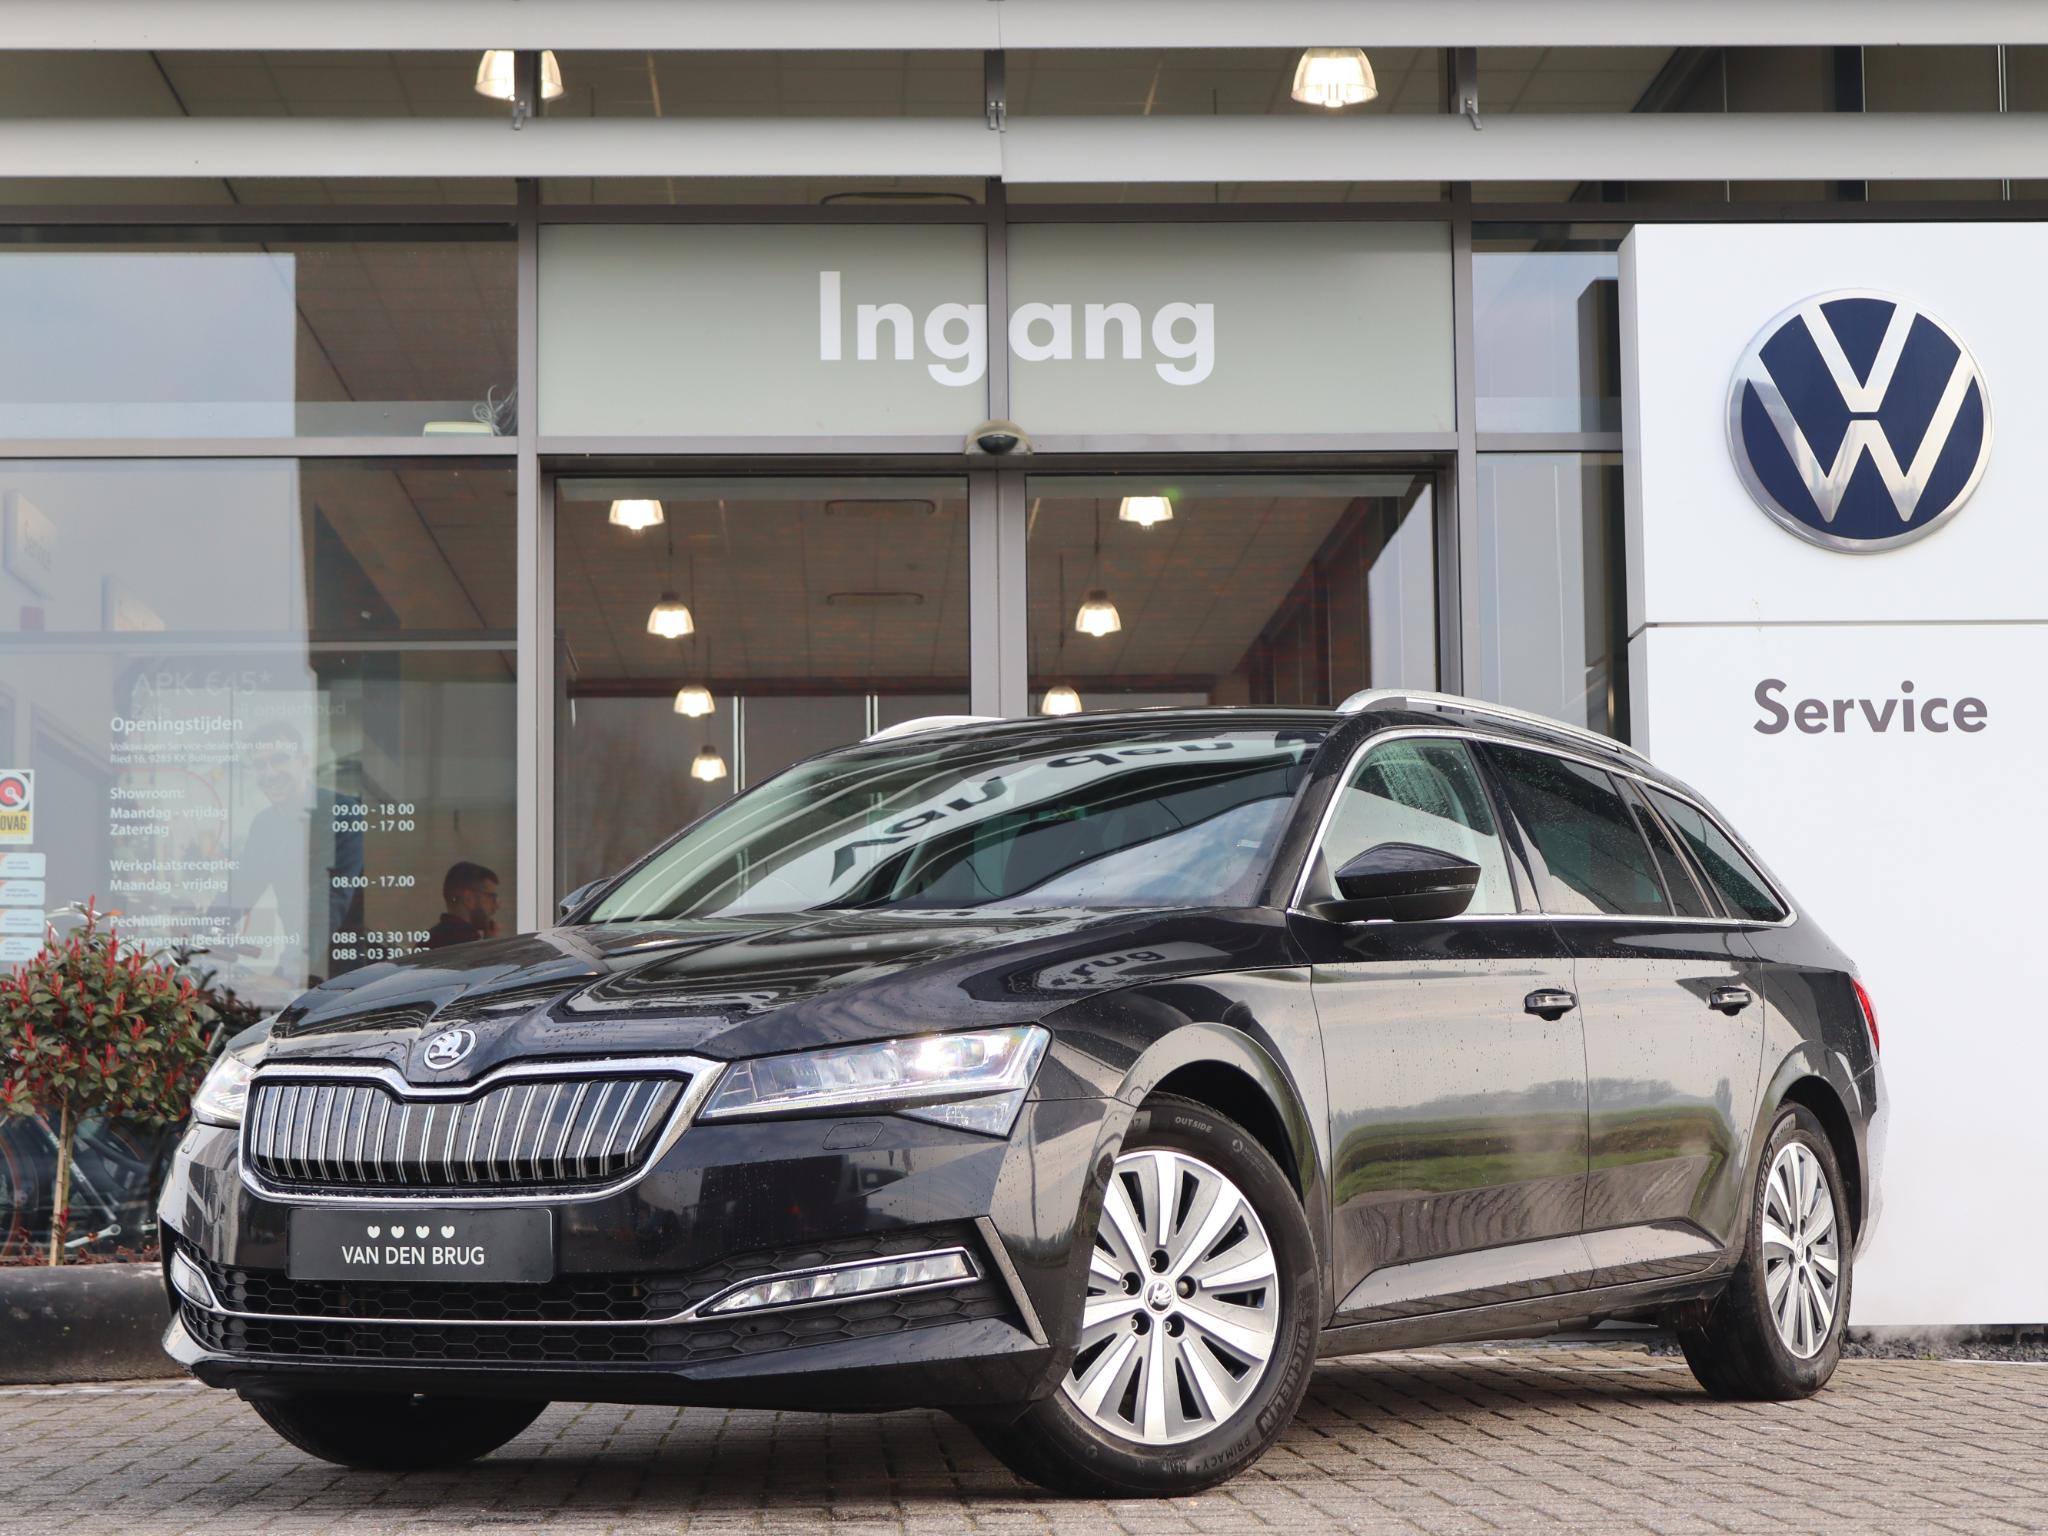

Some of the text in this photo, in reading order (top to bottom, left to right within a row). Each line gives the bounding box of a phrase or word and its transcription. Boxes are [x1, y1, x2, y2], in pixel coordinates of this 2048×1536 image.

[819, 270, 1216, 388] Ingang
[1735, 293, 1988, 540] VW
[1752, 678, 1988, 735] Service
[109, 716, 243, 736] Openingstijden
[109, 787, 185, 800] Showroom:
[109, 807, 172, 820] Maandag
[182, 805, 228, 820] vrijdag
[331, 804, 368, 817] 09.00
[109, 823, 170, 838] Zaterdag
[331, 820, 368, 833] 09.00
[109, 859, 241, 874] Werkplaatsreceptie:
[109, 879, 172, 893] Maandag
[182, 879, 228, 893] vrijdag
[331, 875, 369, 888] 08.00
[379, 875, 416, 888] 17.00
[109, 914, 231, 929] Pechhulpnummer:
[332, 931, 358, 944] 088
[367, 931, 384, 944] 03
[386, 931, 404, 943] 30
[406, 930, 431, 943] 109
[332, 948, 358, 961] 088
[367, 948, 384, 960] 03
[386, 947, 404, 960] 30
[1174, 1115, 1213, 1134] OUTSIDE
[341, 1245, 486, 1265] VAN DEN BRUG
[1259, 1324, 1311, 1433] MICHELIN
[1203, 1433, 1250, 1472] PRIMACY
